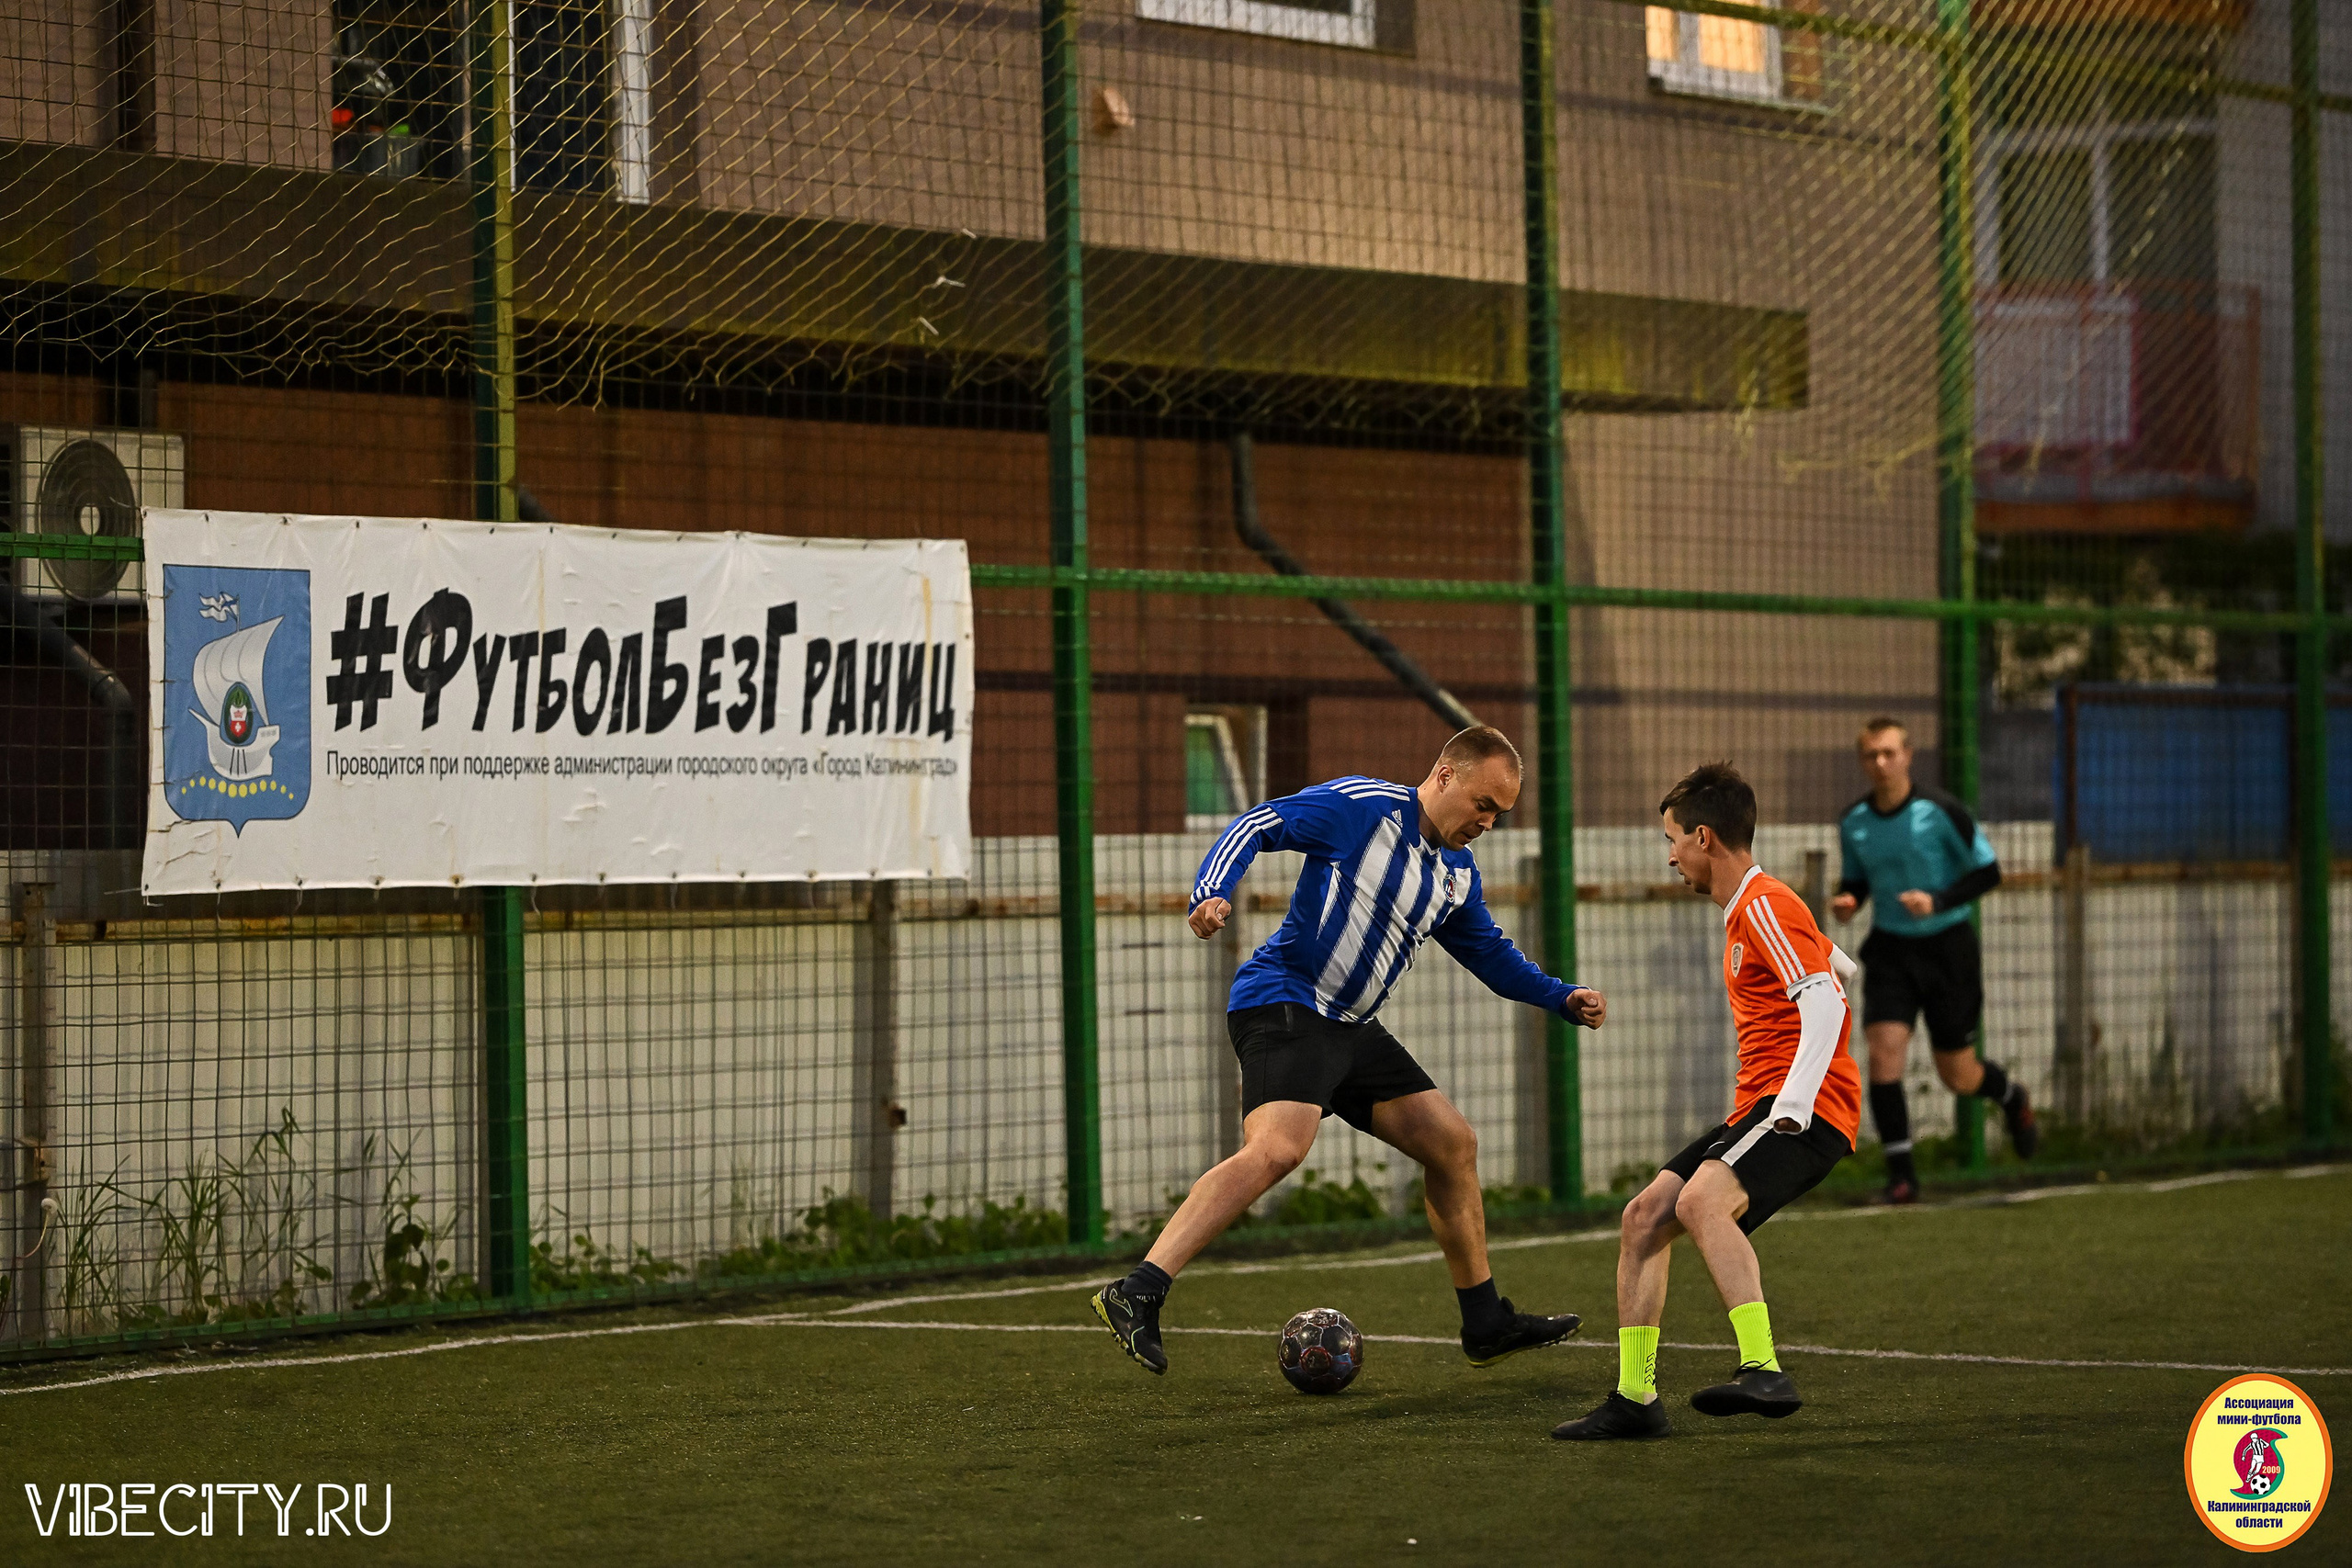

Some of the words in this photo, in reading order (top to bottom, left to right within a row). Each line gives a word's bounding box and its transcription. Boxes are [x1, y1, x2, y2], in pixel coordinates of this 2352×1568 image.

[326, 750, 424, 781] Проводится
[430, 755, 459, 781] при
[463, 755, 549, 781] поддержке
[554, 754, 673, 781] администрации
[676, 755, 758, 781] городского
[762, 754, 808, 781] округа
[813, 751, 862, 781] «Город
